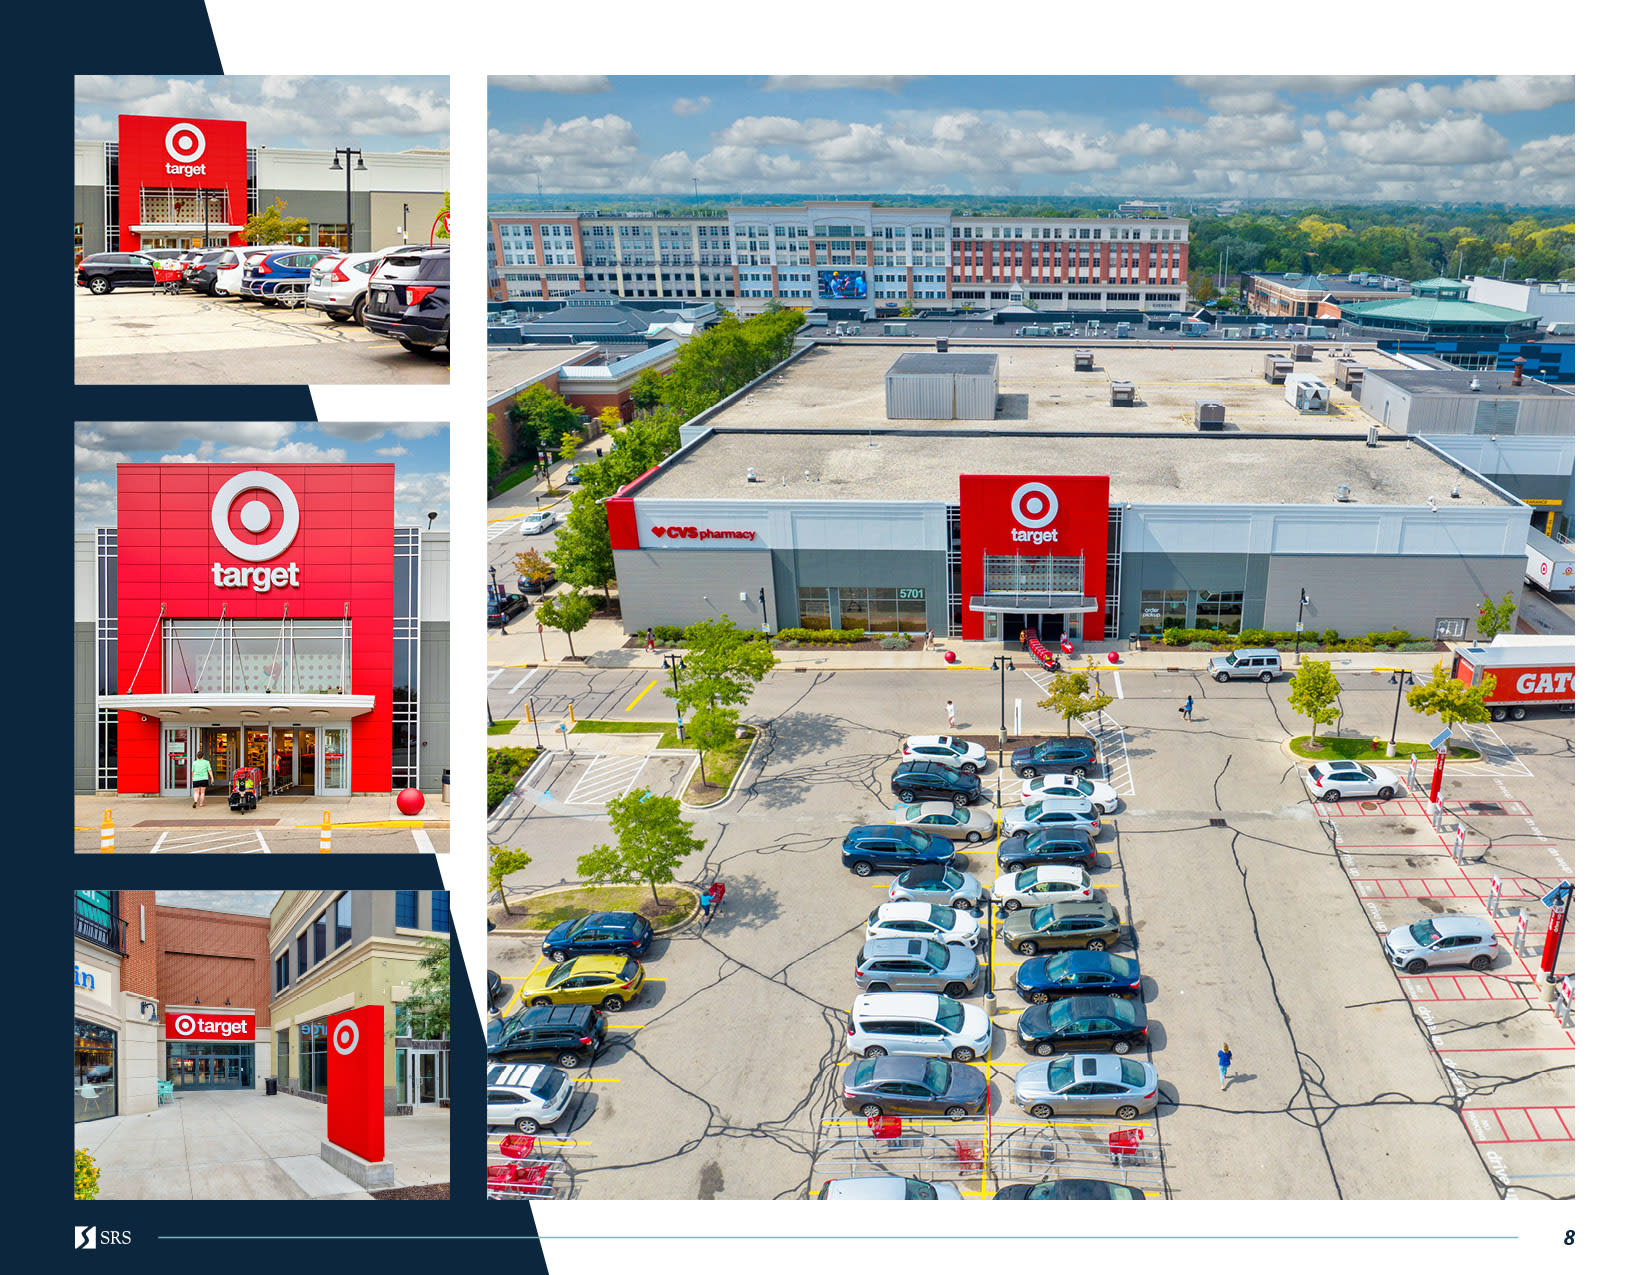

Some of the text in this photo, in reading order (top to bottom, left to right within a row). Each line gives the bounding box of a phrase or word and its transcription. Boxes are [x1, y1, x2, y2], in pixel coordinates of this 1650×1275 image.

[165, 162, 206, 178] target
[666, 526, 756, 541] CVS pharmacy
[1011, 528, 1058, 544] target
[211, 562, 300, 593] target
[900, 588, 924, 599] 5701
[198, 1018, 247, 1037] target
[1486, 1150, 1510, 1185] drive
